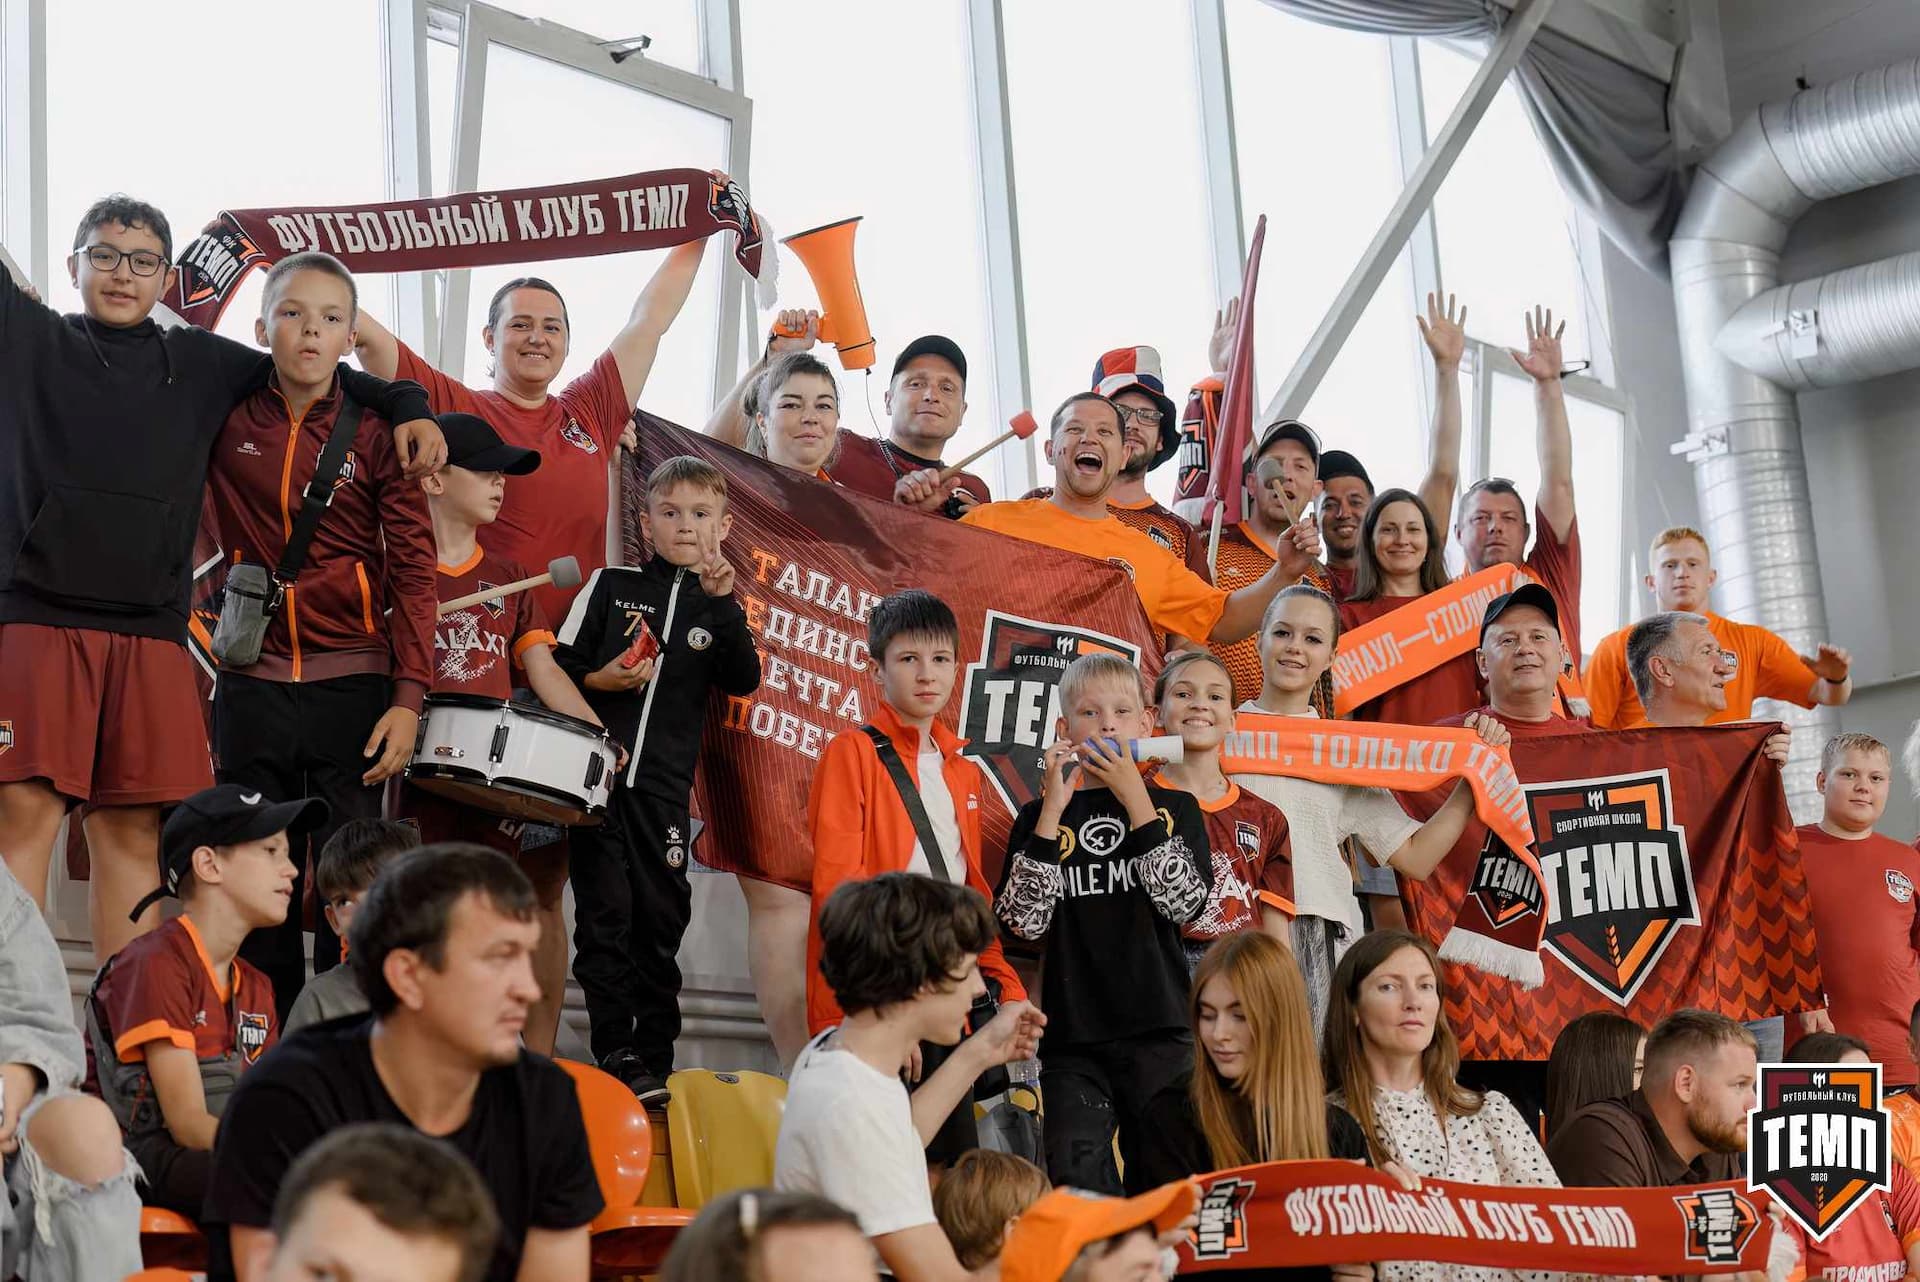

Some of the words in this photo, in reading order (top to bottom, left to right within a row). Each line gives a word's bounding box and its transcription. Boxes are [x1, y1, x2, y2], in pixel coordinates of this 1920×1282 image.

[267, 194, 507, 254] ФУТБОЛЬНЫЙ
[517, 193, 605, 241] КЛУБ
[612, 183, 690, 232] ТЕМП
[186, 234, 239, 289] ТЕМП
[615, 599, 657, 614] KELME
[624, 611, 642, 636] 7
[1310, 733, 1456, 773] ТОЛЬКО
[1555, 814, 1611, 834] СПОРТИВНАЯ
[1611, 812, 1642, 825] ШКОЛА
[1540, 841, 1679, 926] ТЕМП
[1199, 1185, 1235, 1252] ТЕМП
[1284, 1184, 1468, 1237] ФУТБОЛЬНЫЙ
[1458, 1198, 1554, 1243] КЛУБ
[1549, 1204, 1637, 1248] ТЕМП
[1701, 1193, 1735, 1258] ТЕМП
